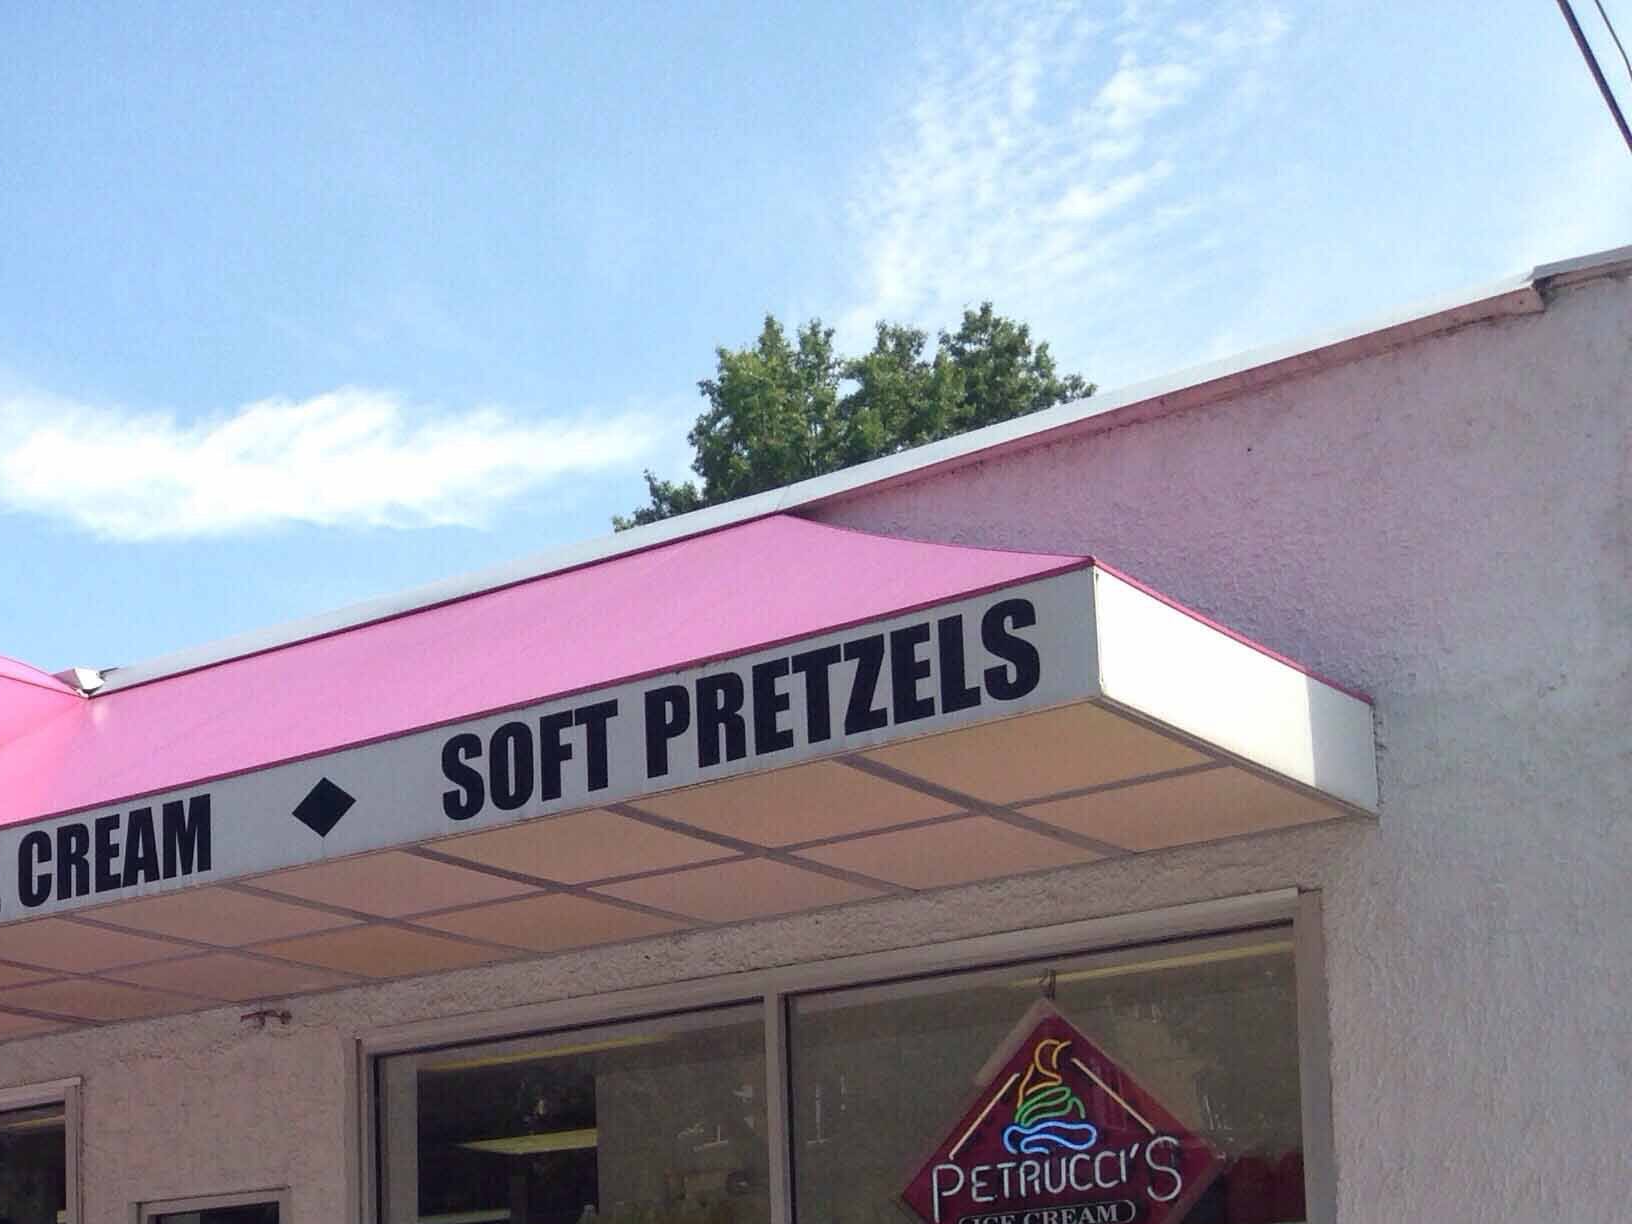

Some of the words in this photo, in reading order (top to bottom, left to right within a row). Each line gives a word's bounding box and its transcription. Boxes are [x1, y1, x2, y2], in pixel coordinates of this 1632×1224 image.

[442, 699, 618, 820] SOFT
[644, 598, 1040, 779] PRETZELS
[18, 794, 211, 908] CREAM
[932, 1136, 1182, 1224] PETRUCCI'S
